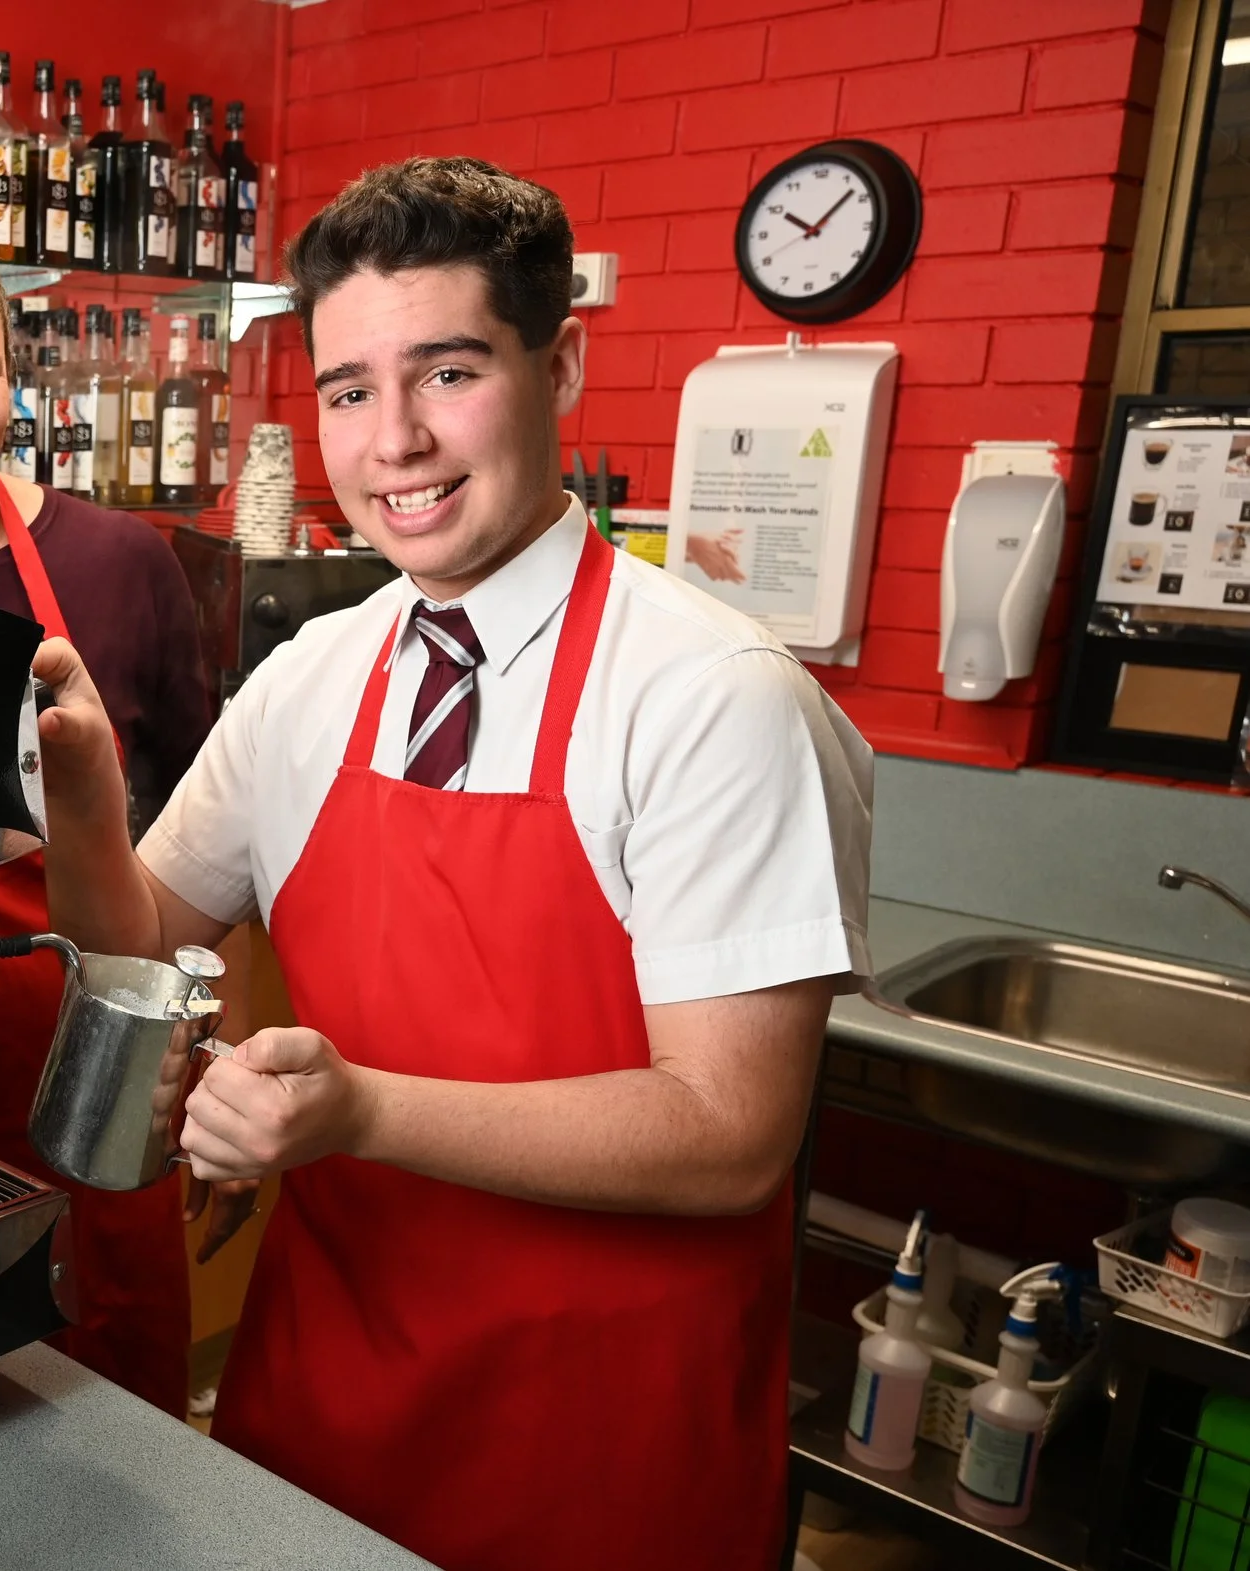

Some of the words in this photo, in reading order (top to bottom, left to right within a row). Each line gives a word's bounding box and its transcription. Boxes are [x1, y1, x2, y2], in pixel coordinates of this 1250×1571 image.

[812, 168, 829, 179] 12
[843, 175, 851, 184] 1
[786, 182, 800, 192] 11
[858, 194, 870, 203] 2
[767, 205, 783, 215] 10
[863, 222, 872, 231] 3
[758, 231, 768, 240] 9
[851, 249, 863, 259] 4
[762, 256, 772, 267] 8
[781, 276, 790, 286] 7
[830, 272, 841, 282] 5
[803, 282, 814, 291] 6
[689, 504, 731, 512] Remember
[744, 506, 767, 514] Wash
[769, 507, 788, 515] Your
[790, 507, 819, 516] Hands
